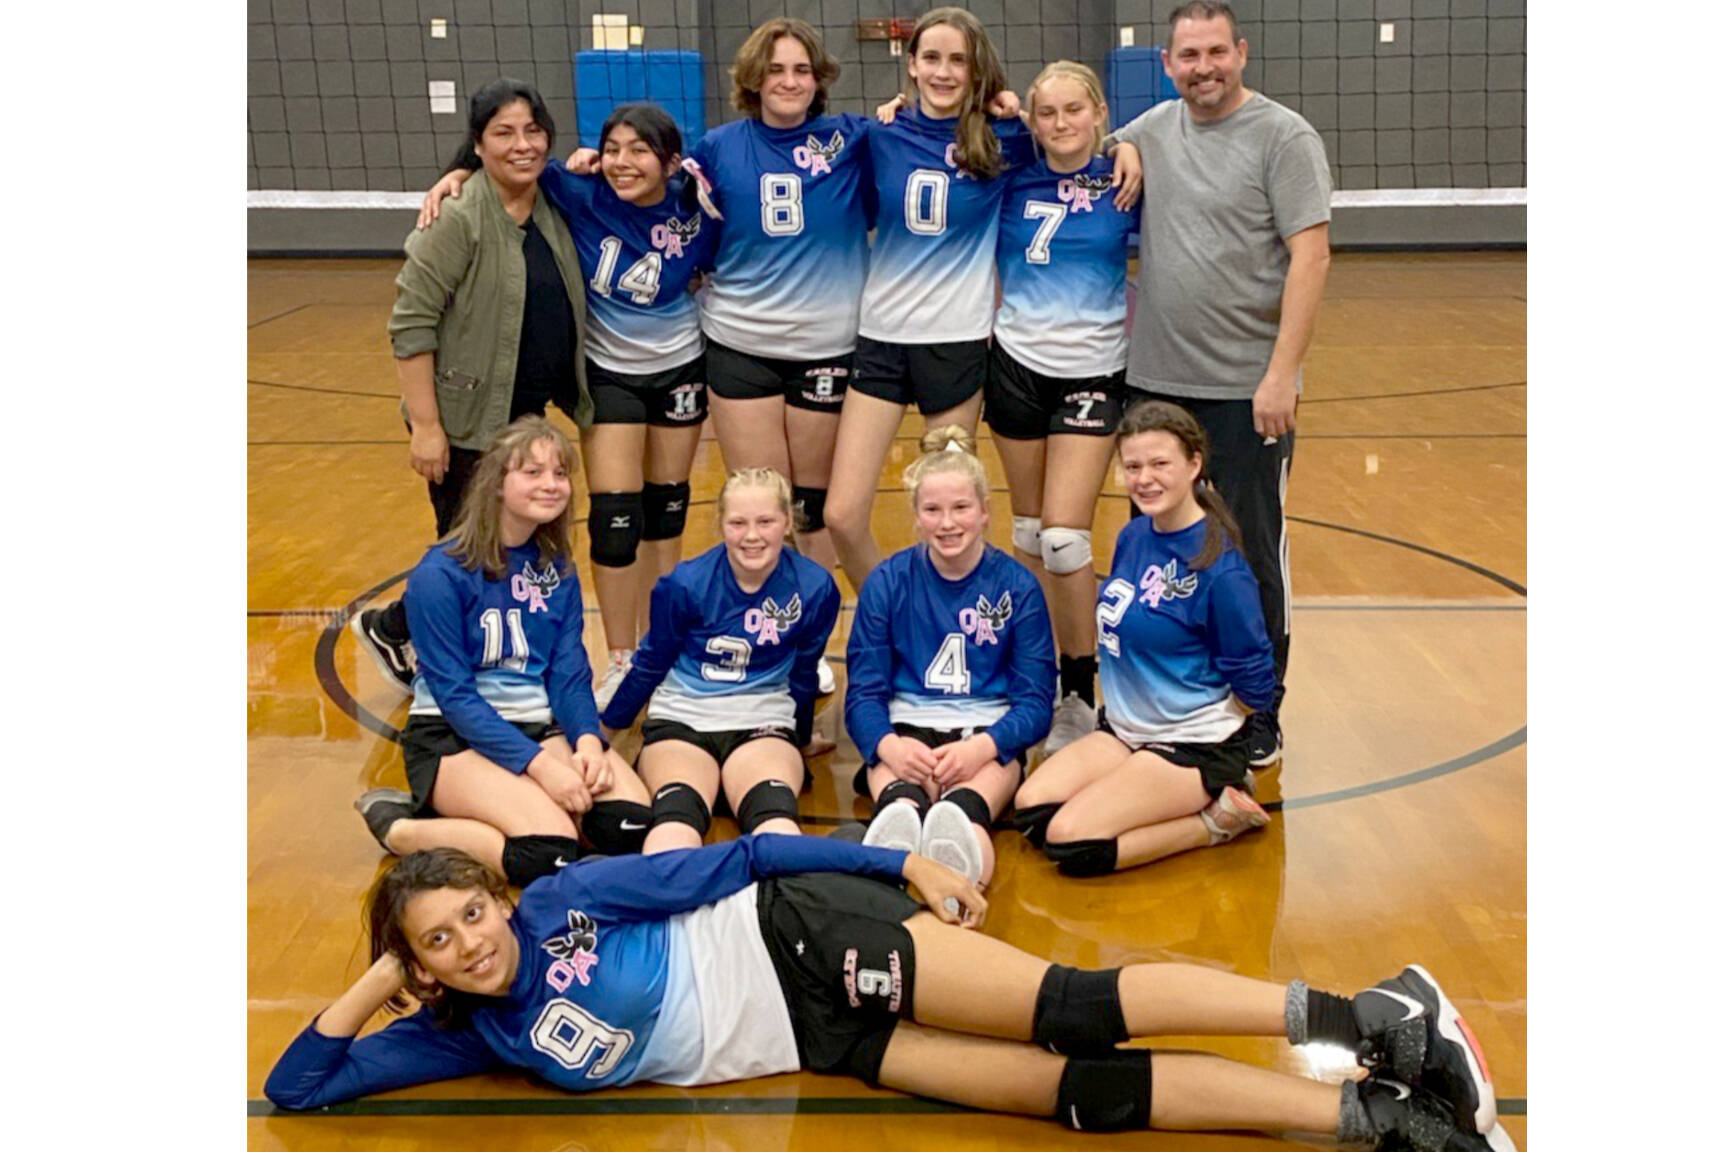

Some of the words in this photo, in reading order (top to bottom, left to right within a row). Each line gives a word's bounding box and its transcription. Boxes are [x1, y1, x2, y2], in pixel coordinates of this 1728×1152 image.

[760, 172, 804, 237] 8
[904, 168, 950, 236] 0
[1023, 200, 1068, 264] 7
[590, 235, 662, 305] 14
[674, 391, 697, 413] 14
[815, 375, 833, 396] 8
[1076, 400, 1094, 419] 7
[480, 608, 529, 673] 11
[1096, 578, 1136, 658] 2
[701, 635, 754, 682] 3
[924, 632, 971, 695] 4
[857, 968, 892, 997] 9
[529, 998, 635, 1080] 9
